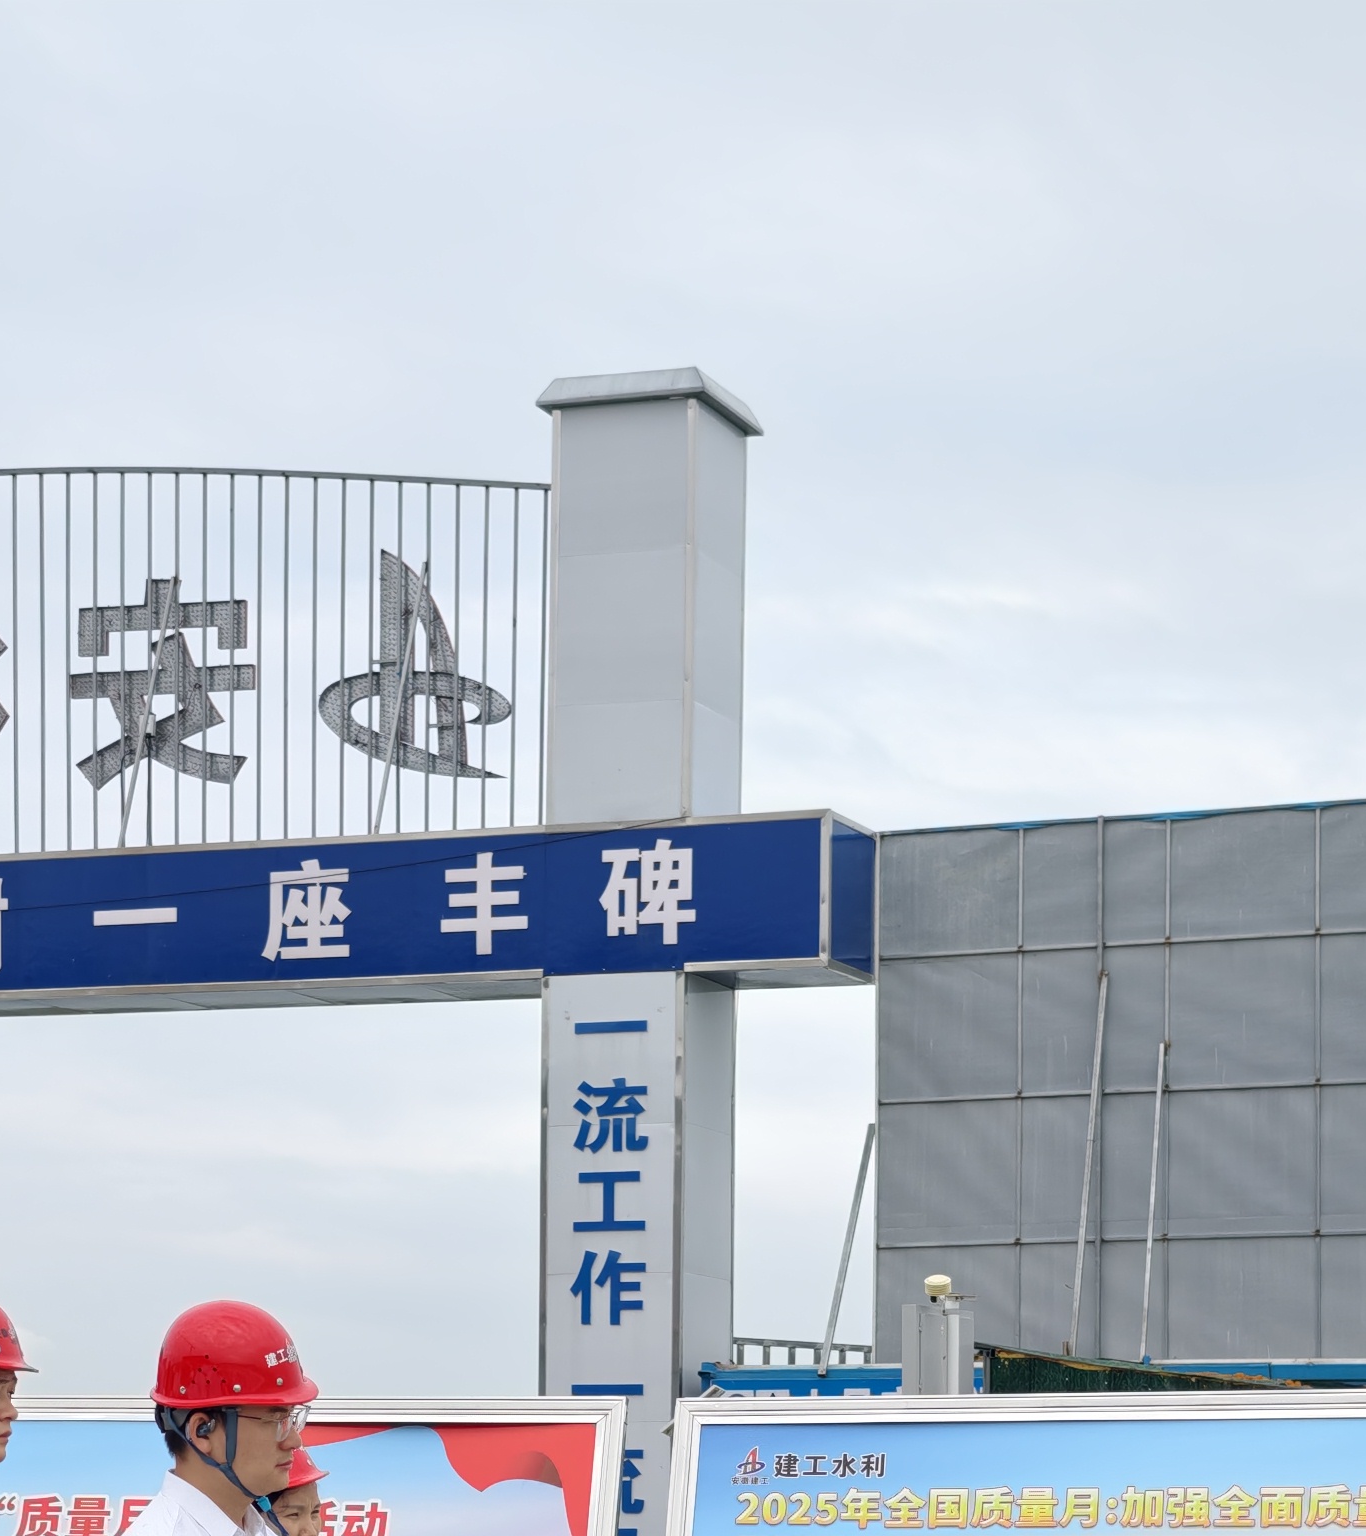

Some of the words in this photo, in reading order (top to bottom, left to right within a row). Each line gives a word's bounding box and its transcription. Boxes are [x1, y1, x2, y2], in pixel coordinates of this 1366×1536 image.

[570, 1019, 648, 1326] 一流工作
[774, 1453, 885, 1478] 建工水利
